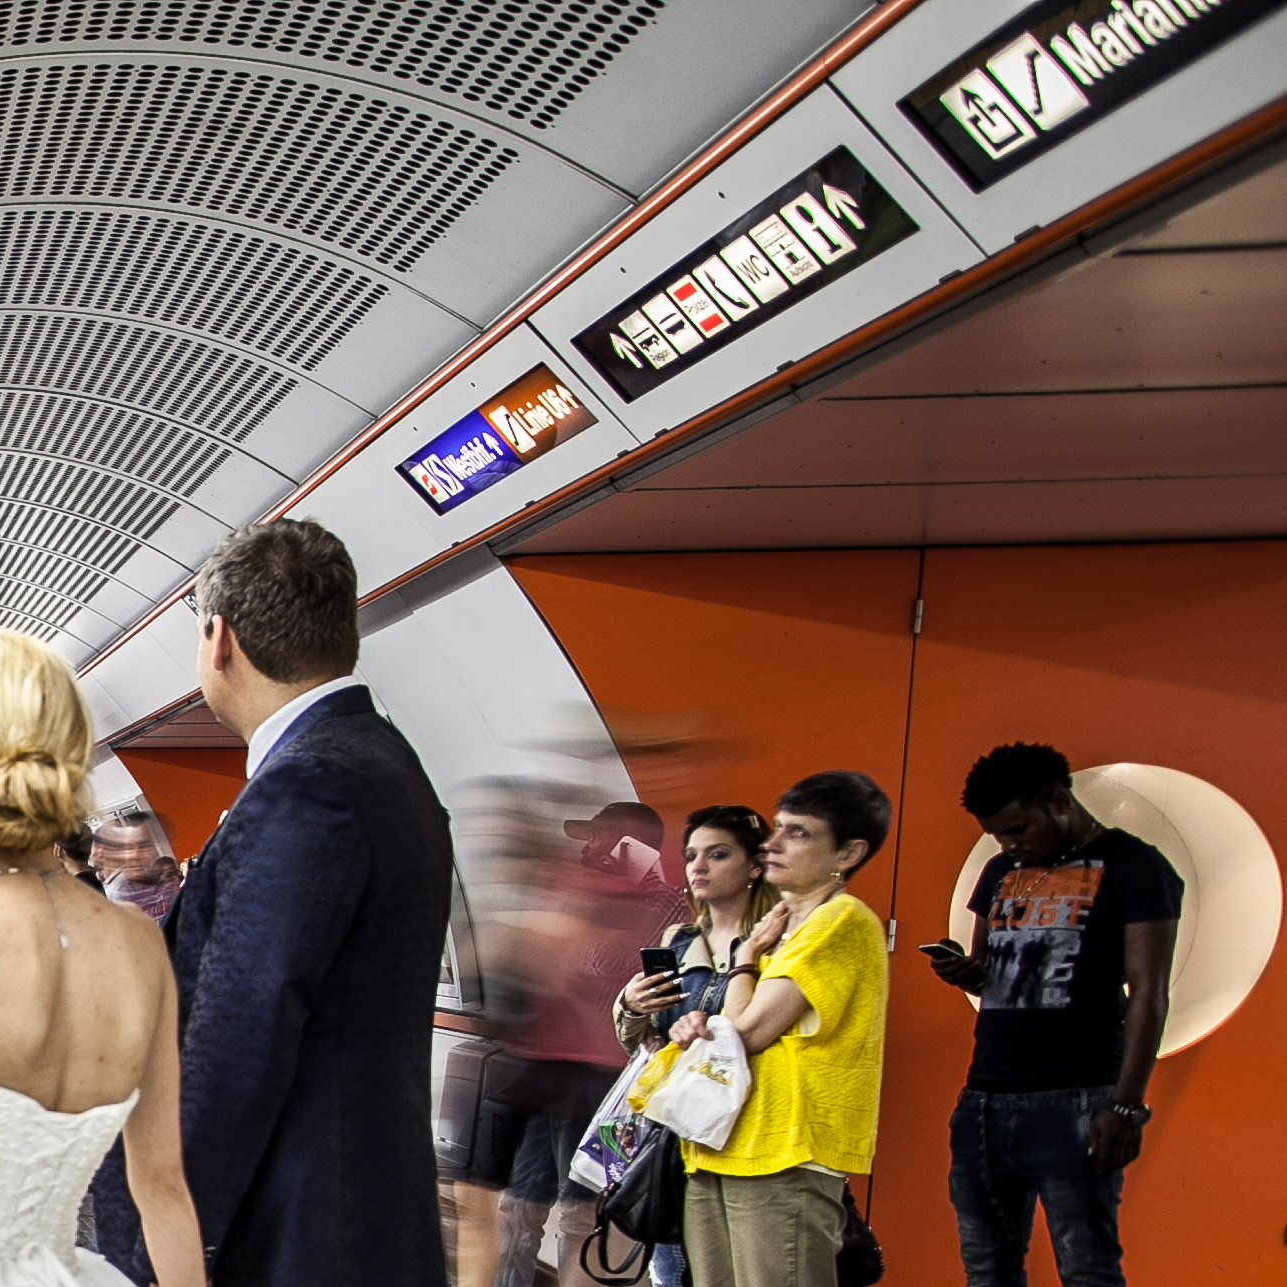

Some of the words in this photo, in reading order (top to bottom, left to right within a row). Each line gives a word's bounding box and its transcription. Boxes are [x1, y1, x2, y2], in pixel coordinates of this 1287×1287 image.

[735, 254, 770, 285] WC
[789, 260, 814, 277] Aufsicht
[684, 299, 710, 316] Polizei
[511, 401, 555, 437] Linie
[537, 388, 571, 419] U6
[442, 436, 496, 481] Westbhf.
[988, 899, 1094, 928] LOST
